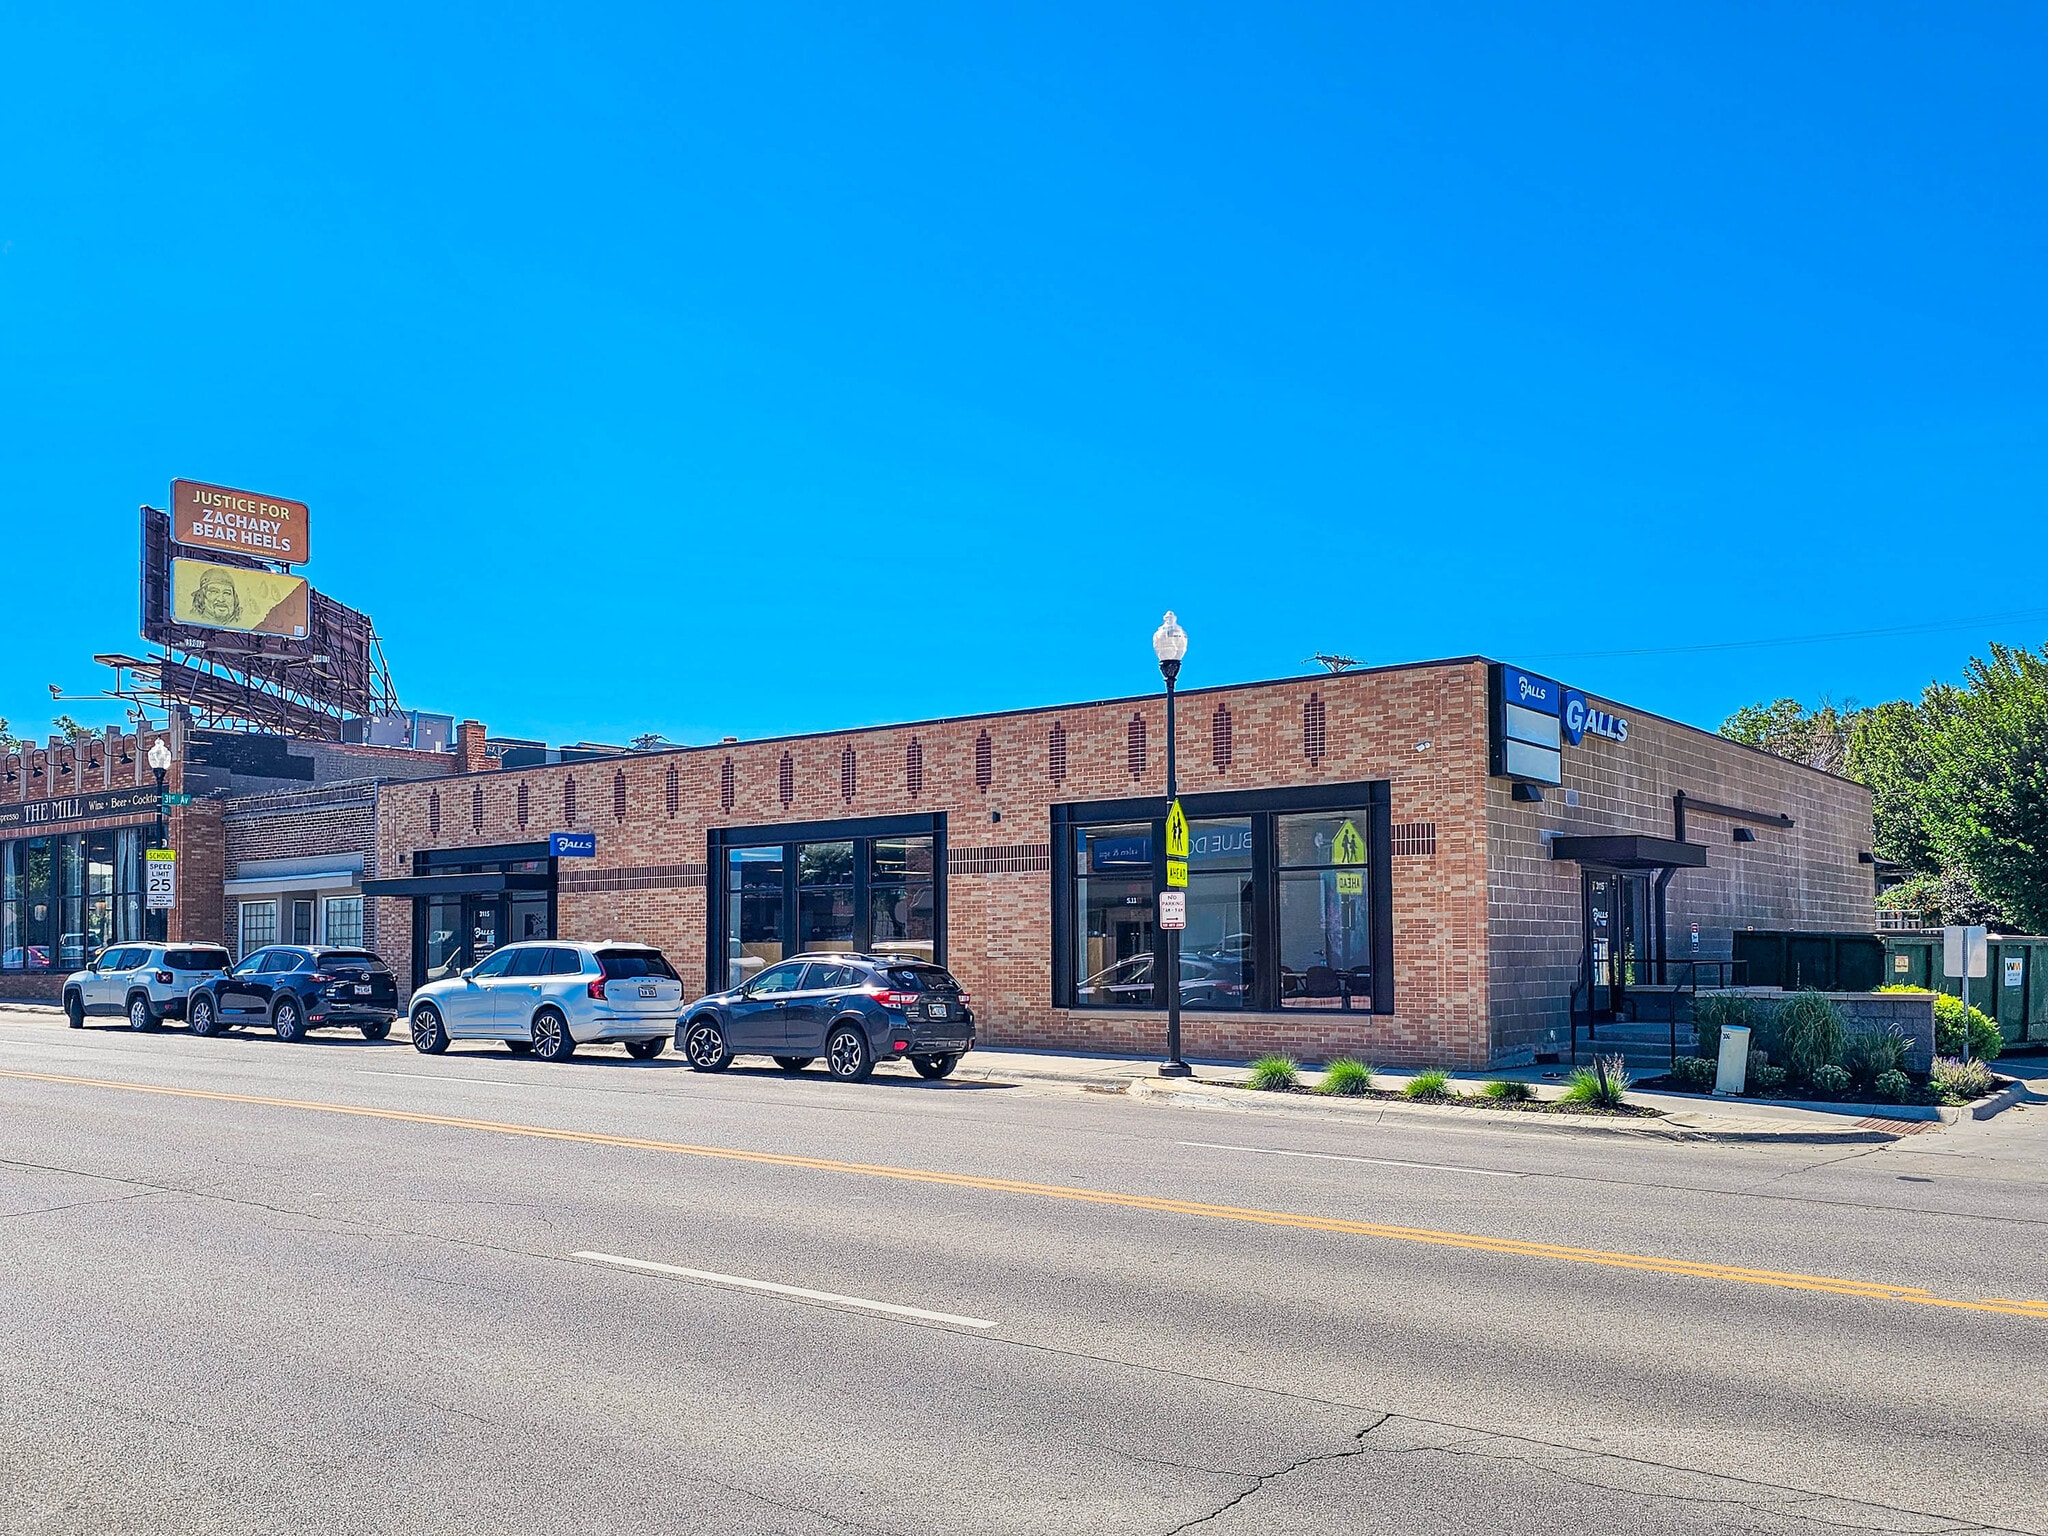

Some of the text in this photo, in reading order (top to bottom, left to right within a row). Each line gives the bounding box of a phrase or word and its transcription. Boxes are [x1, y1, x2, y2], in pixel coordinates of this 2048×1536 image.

[193, 491, 290, 520] JUSTICE FOR
[202, 509, 281, 535] ZACHARY
[192, 522, 237, 542] BEAR
[241, 531, 291, 551] HEELS
[1519, 676, 1546, 700] GALLS
[1566, 699, 1629, 742] GALLS
[23, 802, 49, 823] THE
[51, 798, 83, 820] MILL
[88, 801, 105, 811] Wine
[111, 797, 127, 808] Beer
[132, 793, 158, 805] Cockta
[149, 852, 173, 860] SCHOOL
[556, 837, 592, 852] GALLS
[150, 878, 171, 891] 25
[1170, 867, 1186, 880] AHEAD
[2006, 962, 2021, 971] WM
